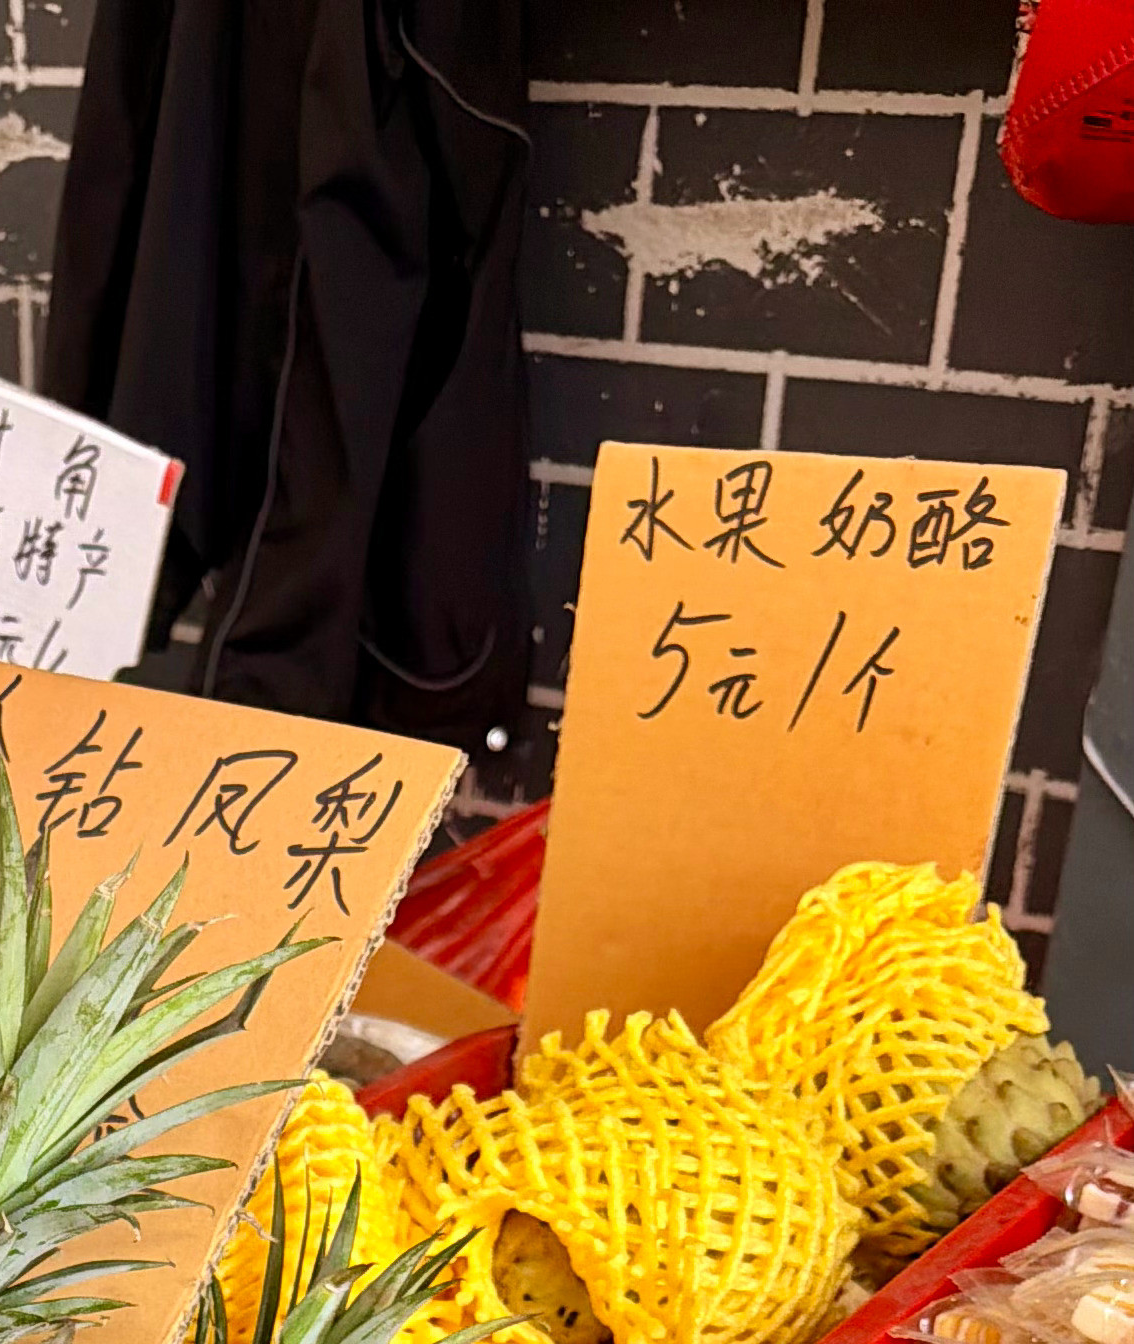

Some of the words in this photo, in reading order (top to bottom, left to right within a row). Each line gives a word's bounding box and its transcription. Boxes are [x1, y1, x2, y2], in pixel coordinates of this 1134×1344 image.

[620, 456, 1012, 570] 水果奶酪
[636, 601, 901, 733] 5元/个
